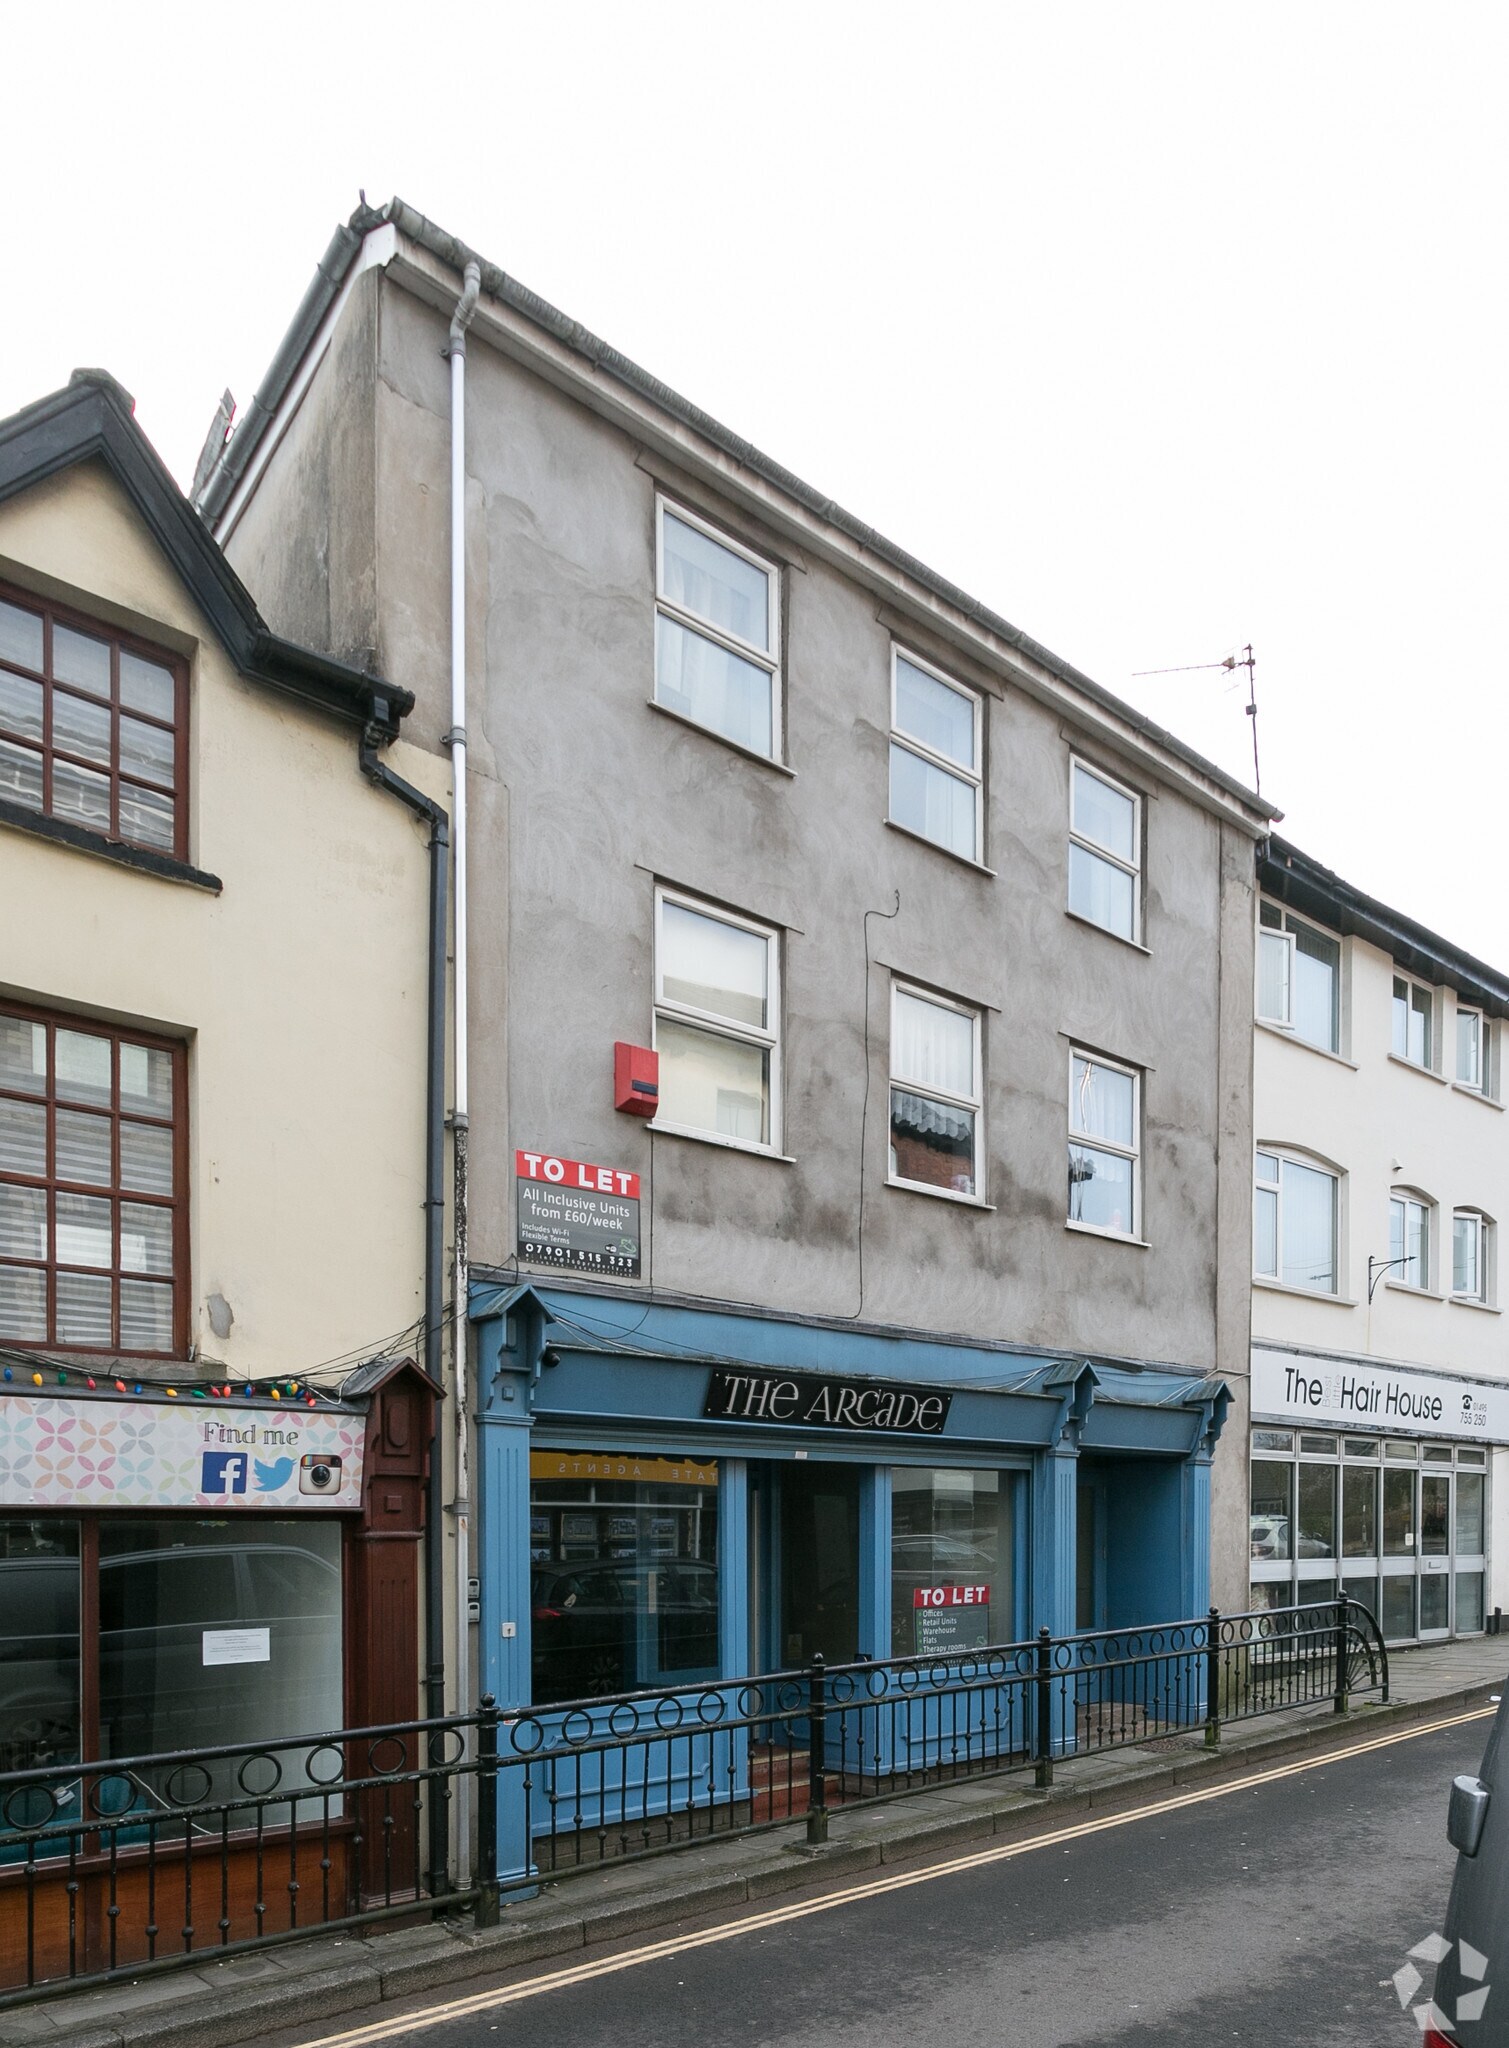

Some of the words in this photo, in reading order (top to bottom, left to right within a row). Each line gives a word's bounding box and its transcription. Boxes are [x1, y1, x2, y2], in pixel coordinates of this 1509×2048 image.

[523, 1153, 565, 1182] TO
[578, 1164, 632, 1195] LET
[522, 1187, 540, 1201] All
[543, 1191, 596, 1212] Inclusive
[600, 1201, 630, 1218] Units
[531, 1203, 561, 1220] from
[564, 1211, 623, 1231] £60/week
[521, 1222, 551, 1234] Includes
[551, 1227, 570, 1237] Wi-Fi
[521, 1230, 549, 1242] Flexible
[550, 1234, 570, 1245] Terms
[525, 1243, 571, 1258] 07901
[578, 1250, 602, 1263] 515
[609, 1255, 633, 1268] 323
[1285, 1367, 1323, 1406] The
[1340, 1375, 1382, 1414] Hair
[1385, 1382, 1443, 1421] House
[1459, 1411, 1473, 1425] 755
[1473, 1412, 1487, 1427] 250
[203, 1421, 256, 1444] Find
[263, 1429, 299, 1446] me
[920, 1588, 945, 1606] TO
[952, 1586, 986, 1605] LET
[922, 1609, 944, 1618] Offices
[922, 1618, 941, 1627] Retail
[941, 1617, 958, 1626] Units
[922, 1626, 957, 1636] Warehouse
[922, 1636, 938, 1645] Flats
[922, 1645, 947, 1654] Therapy
[947, 1643, 967, 1652] rooms
